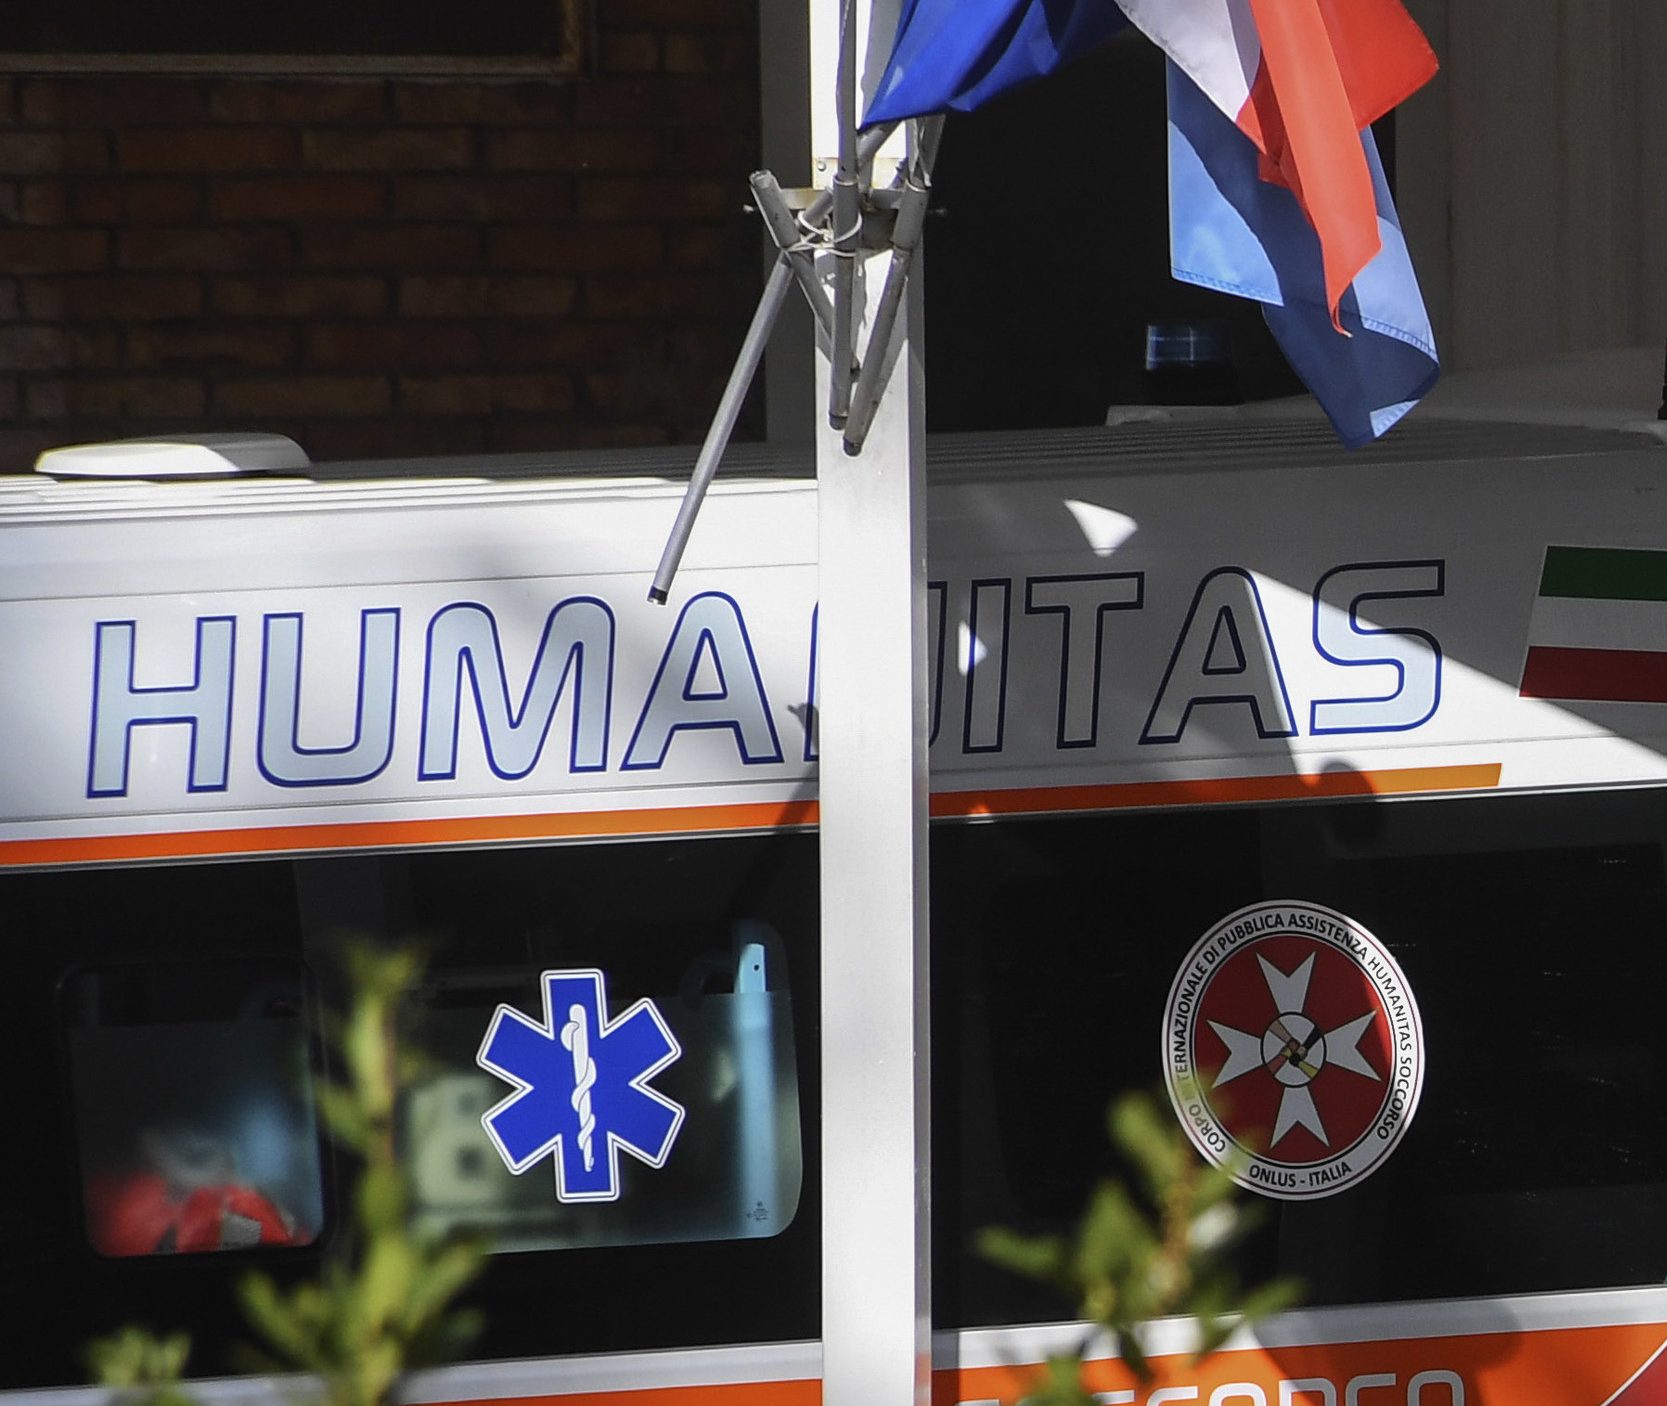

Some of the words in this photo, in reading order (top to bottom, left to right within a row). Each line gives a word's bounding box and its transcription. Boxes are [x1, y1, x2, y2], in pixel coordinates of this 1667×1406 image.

[86, 559, 1445, 799] HUMAITAS
[1216, 913, 1285, 950] PUBBLICA
[1288, 913, 1368, 961] ASSISTENZA
[1204, 948, 1221, 964] DI
[1367, 956, 1413, 1052] HUMANITAS
[1376, 1056, 1413, 1140] SOCCORSO
[1188, 1104, 1226, 1153] CORPO
[1249, 1163, 1297, 1188] ONLUS
[1308, 1161, 1353, 1187] ITALIA
